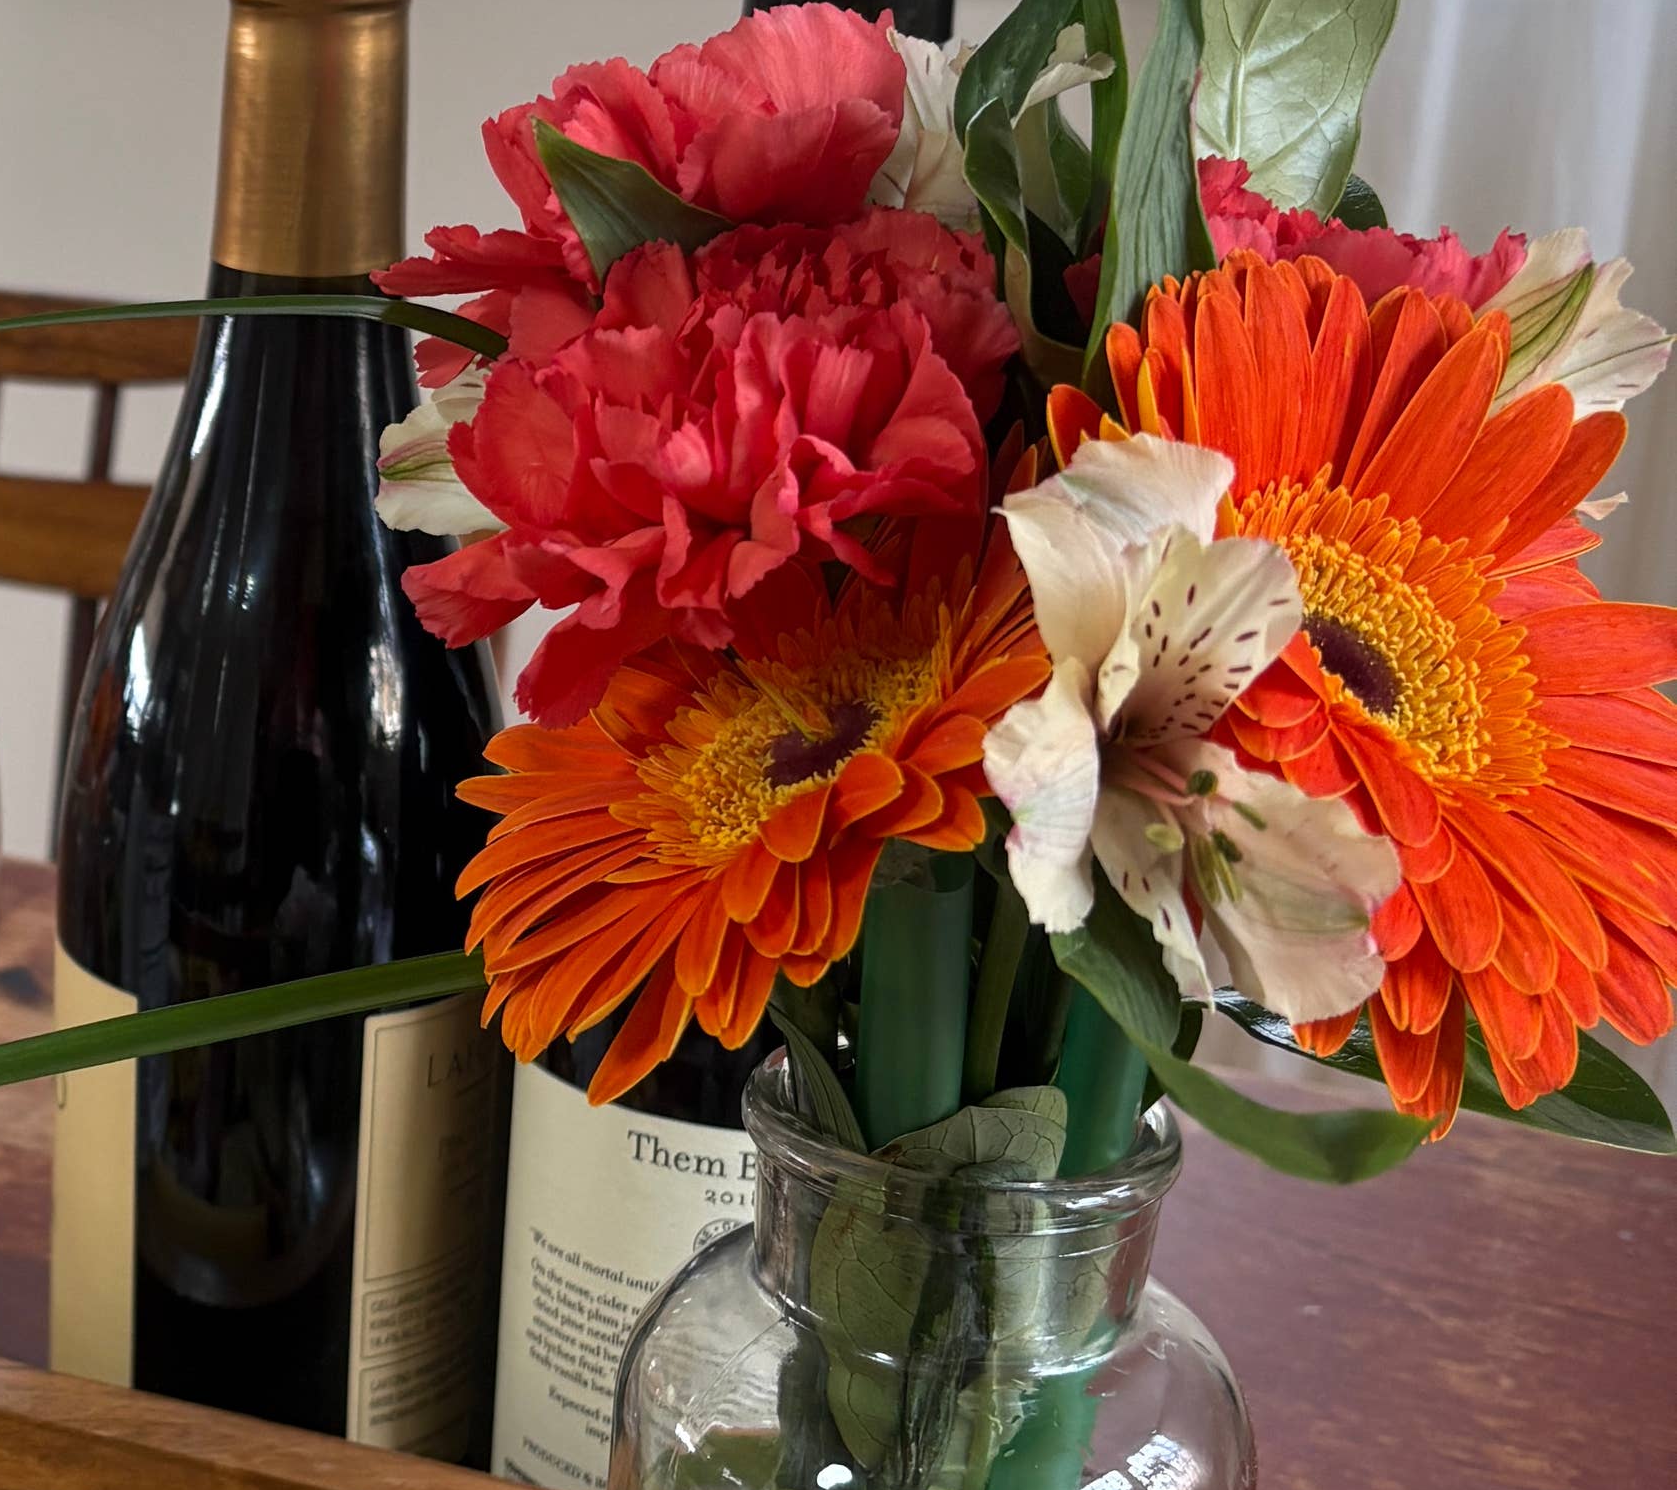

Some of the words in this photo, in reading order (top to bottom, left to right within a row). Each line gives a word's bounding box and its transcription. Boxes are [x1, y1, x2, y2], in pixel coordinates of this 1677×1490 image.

[626, 1129, 728, 1178] Them
[565, 1252, 581, 1266] all
[582, 1259, 624, 1284] mortal
[547, 1269, 563, 1286] the
[596, 1294, 628, 1313] cider
[586, 1308, 619, 1329] plum
